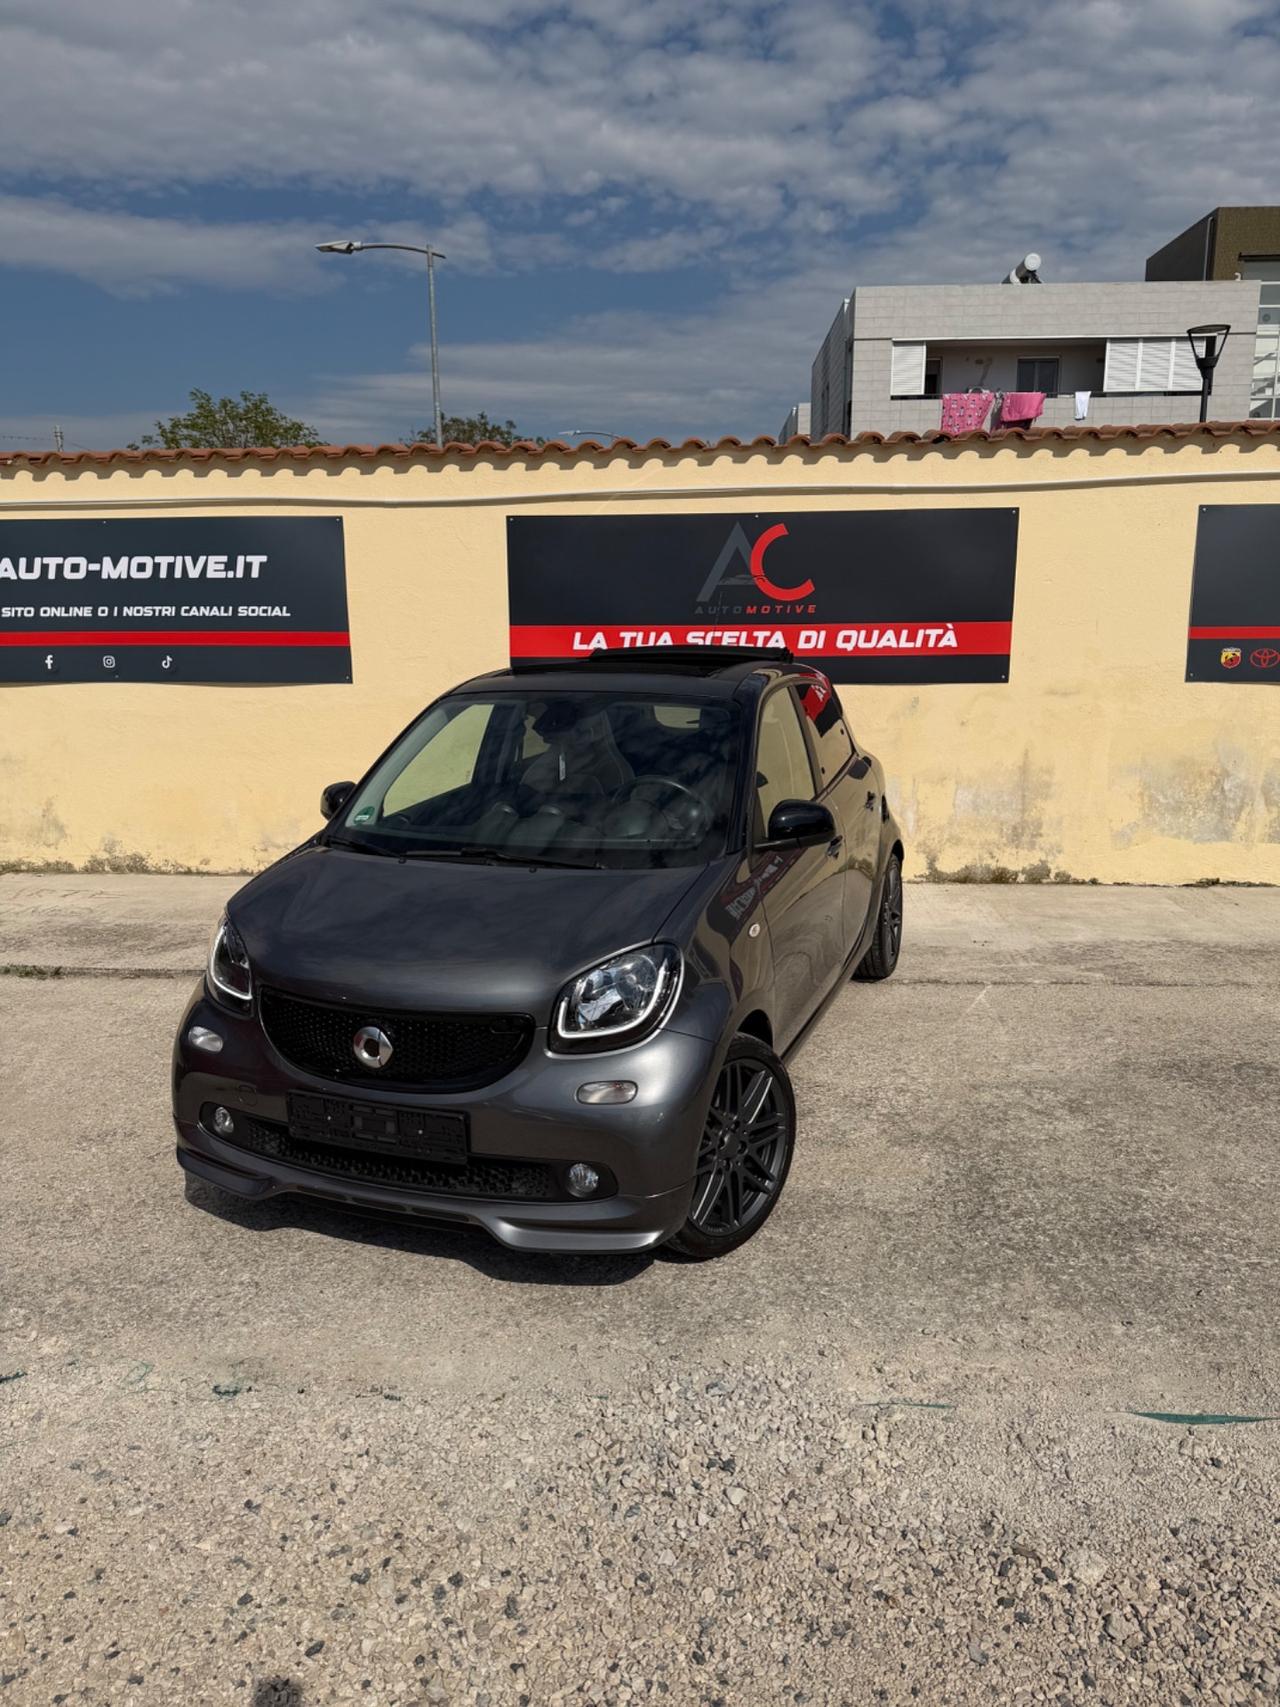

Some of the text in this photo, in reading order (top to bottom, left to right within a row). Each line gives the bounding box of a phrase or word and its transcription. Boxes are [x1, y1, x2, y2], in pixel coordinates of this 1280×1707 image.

[0, 555, 268, 580] AUTO-MOTIVE.IT
[1, 606, 291, 617] SITO ONLINE O I NOSTRI CANALI SOCIAL
[572, 623, 958, 652] LA TUA SCELTA DI QUALITÀ
